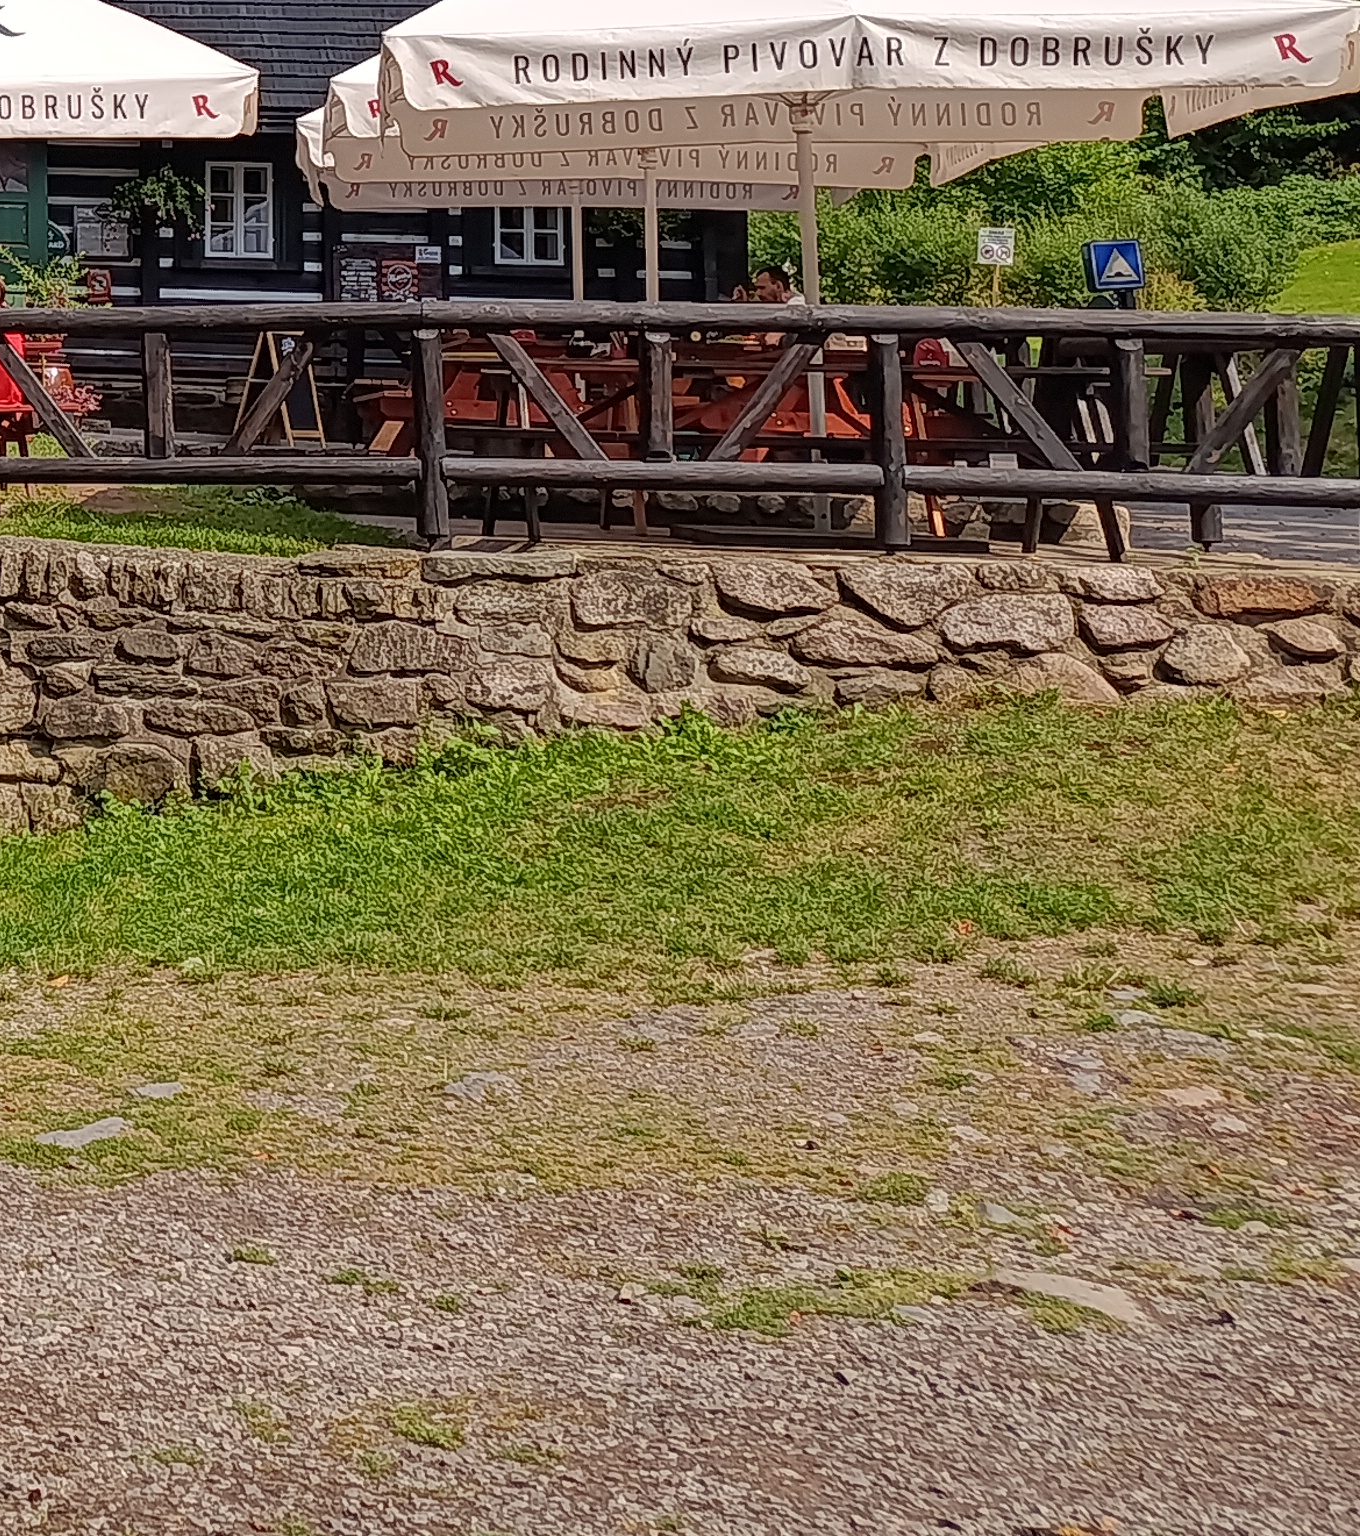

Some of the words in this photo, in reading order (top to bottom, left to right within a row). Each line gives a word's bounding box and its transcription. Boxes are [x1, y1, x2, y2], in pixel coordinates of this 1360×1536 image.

[513, 37, 694, 85] RODINNÝ
[722, 34, 905, 74] PIVOVAR
[933, 36, 951, 67] Z
[980, 27, 1216, 67] DOBRUŠKY
[1274, 33, 1314, 65] R
[430, 58, 464, 88] R
[191, 94, 222, 120] R
